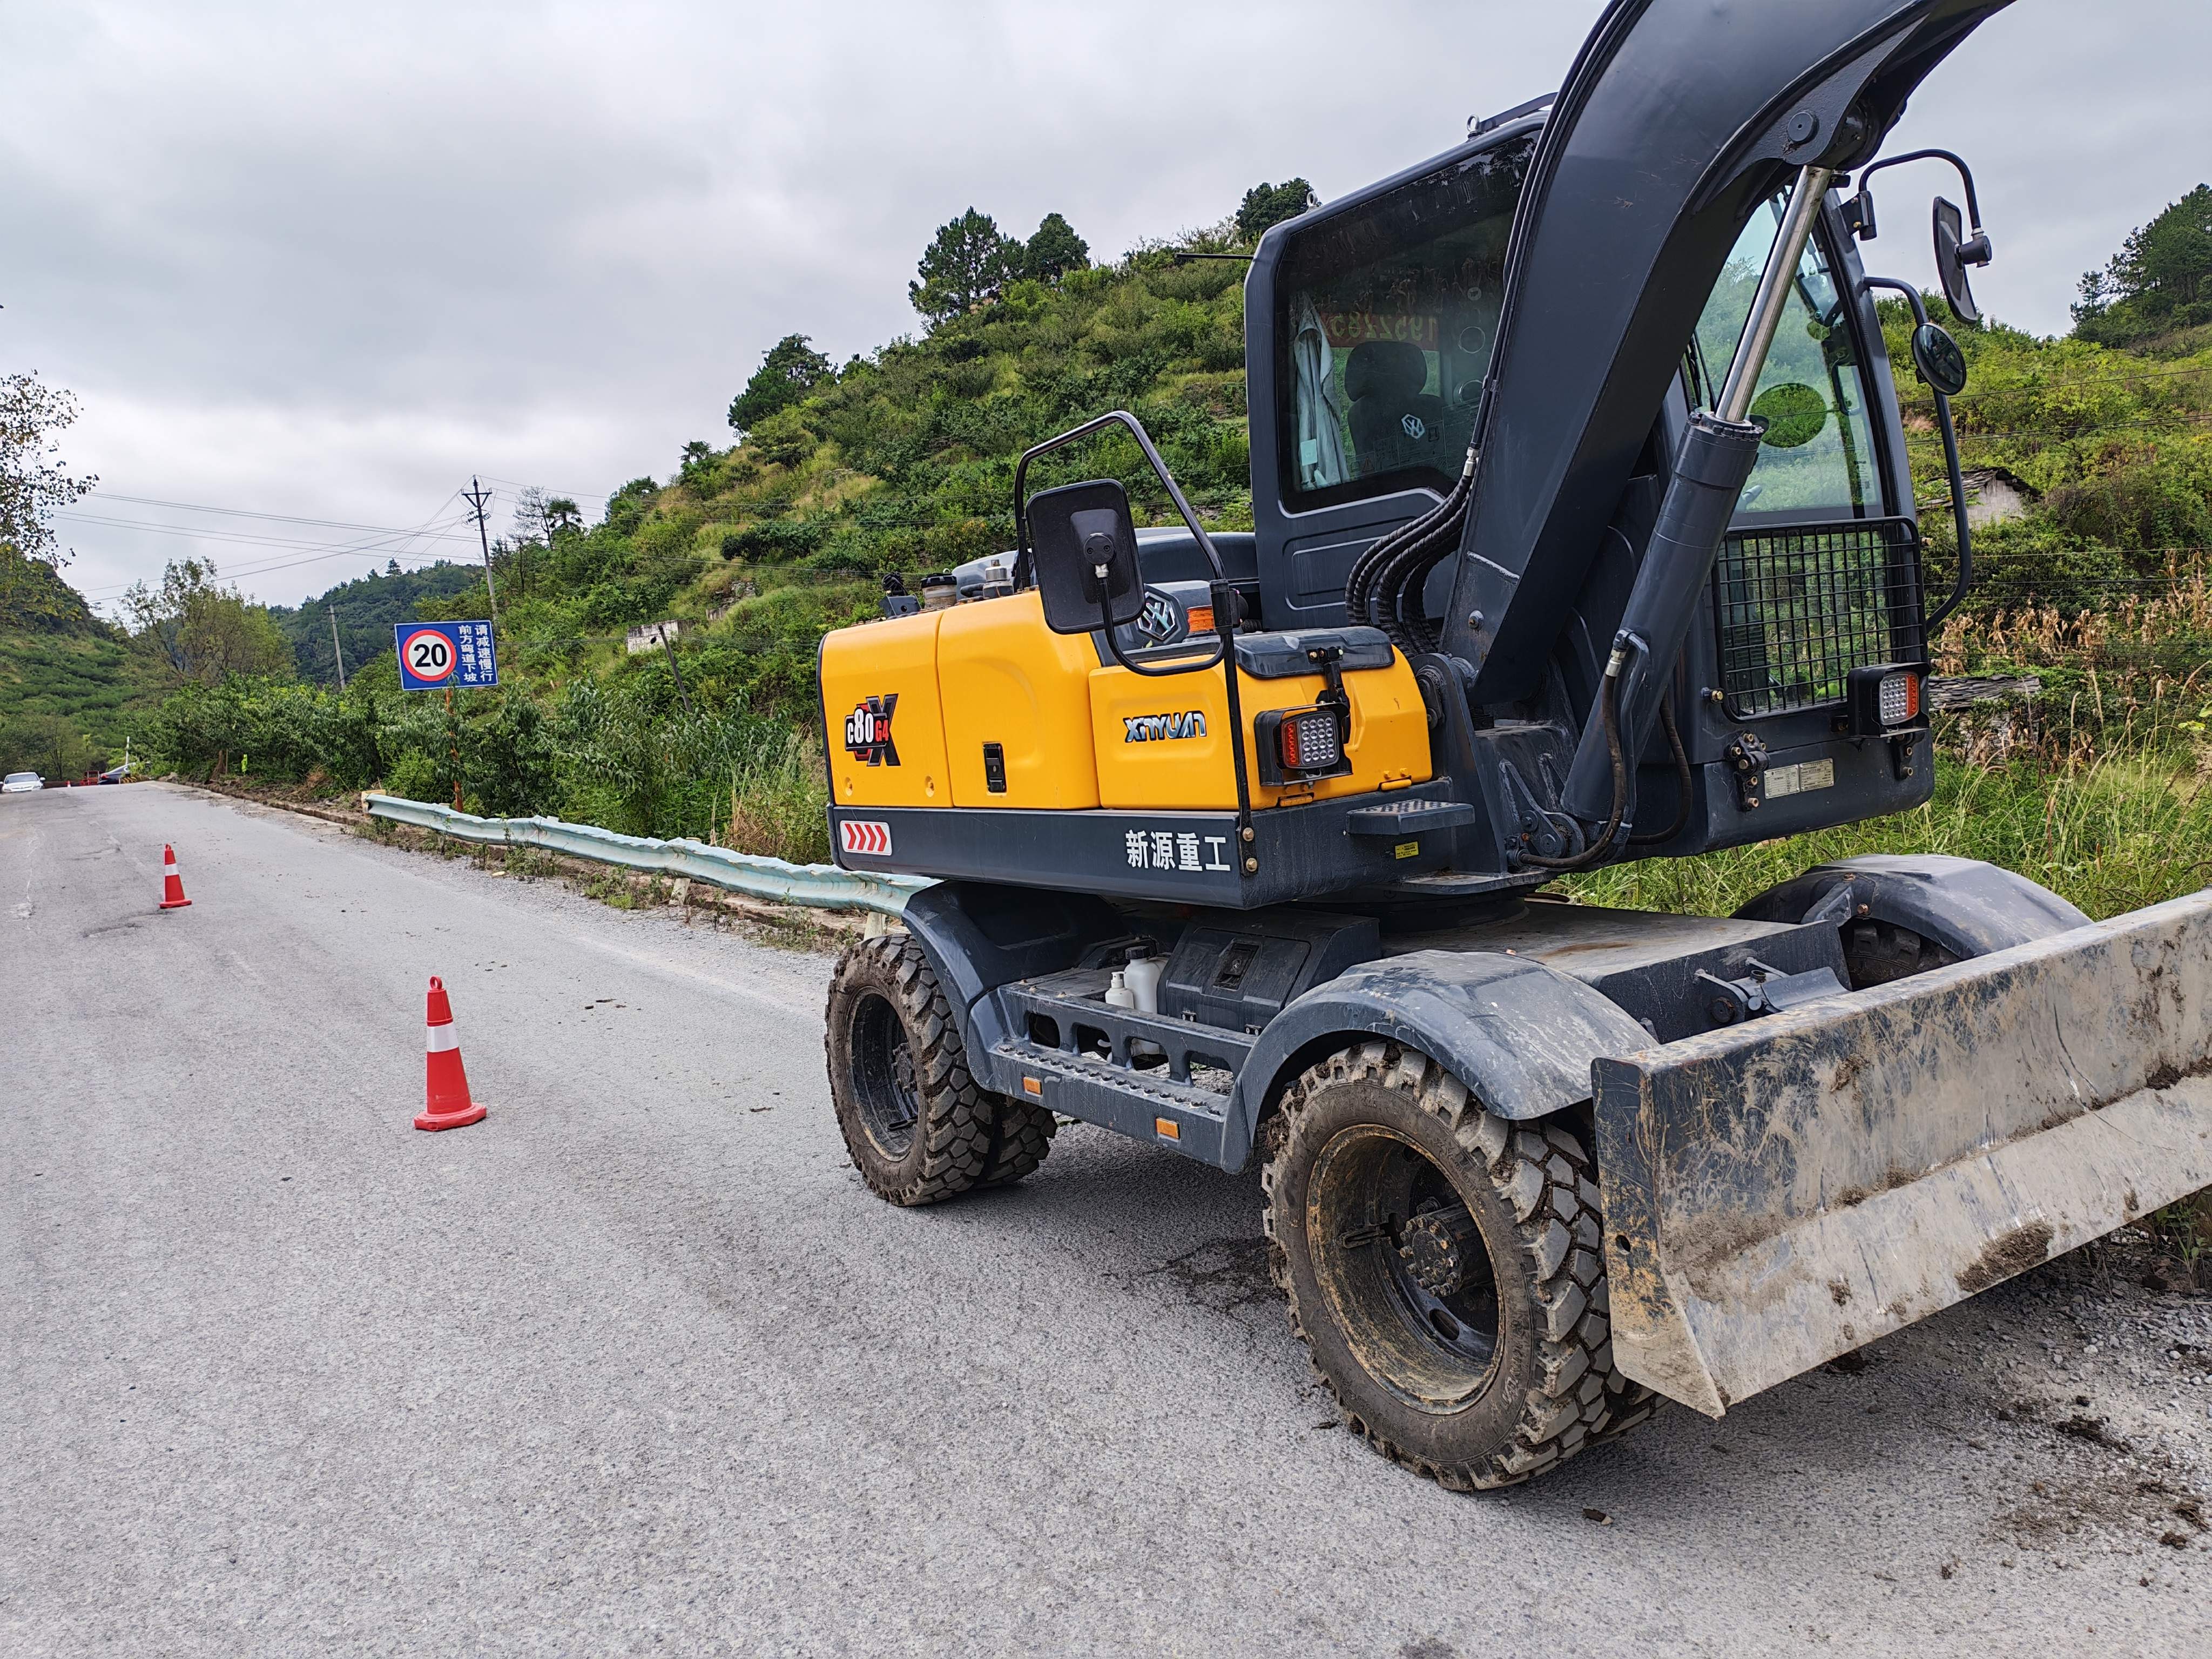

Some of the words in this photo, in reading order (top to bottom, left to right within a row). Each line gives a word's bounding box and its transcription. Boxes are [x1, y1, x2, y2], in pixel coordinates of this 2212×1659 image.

[414, 644, 447, 667] 20
[458, 625, 477, 682] 前方弯道下坡
[475, 624, 493, 682] 请减速慢行
[1125, 830, 1231, 871] 新源重工
